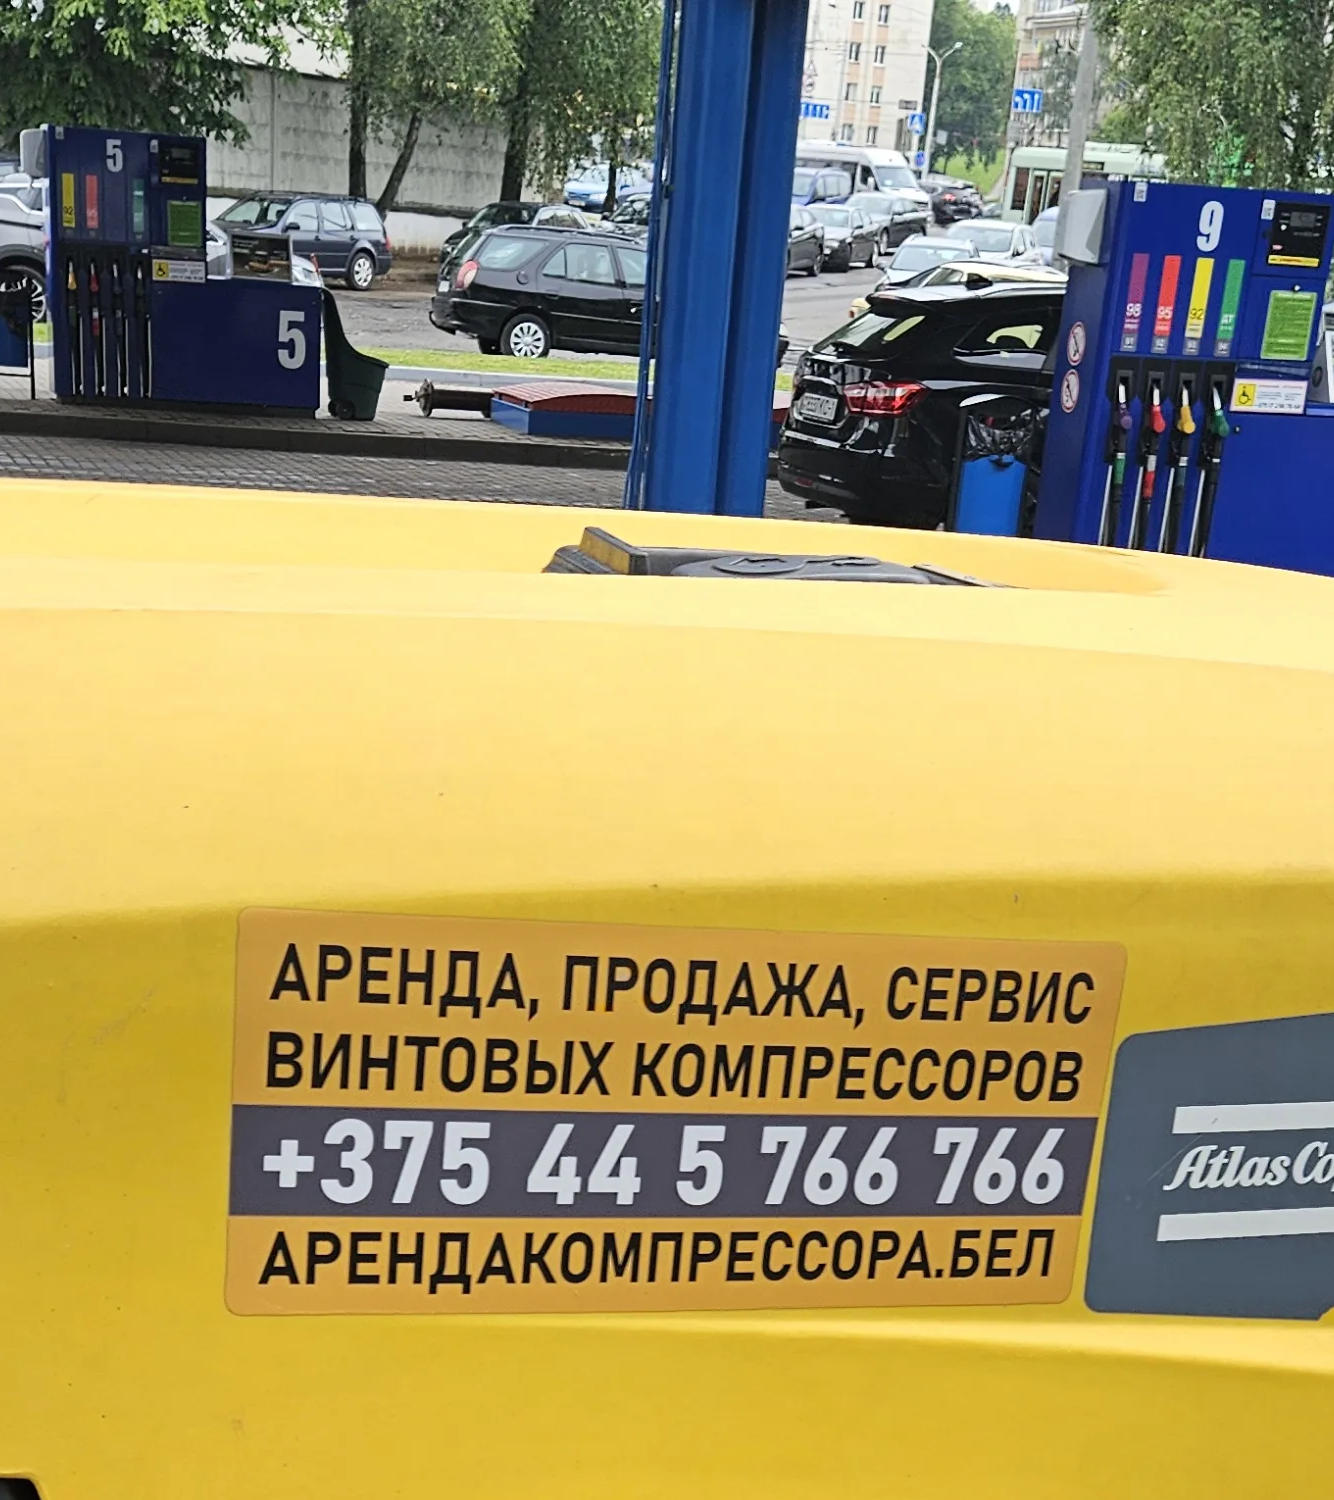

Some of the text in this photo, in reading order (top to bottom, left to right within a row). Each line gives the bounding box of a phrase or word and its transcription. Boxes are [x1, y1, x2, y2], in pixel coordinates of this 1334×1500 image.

[105, 139, 123, 172] 5
[1196, 201, 1224, 252] 9
[277, 310, 306, 369] 5
[1126, 303, 1142, 318] 98
[1157, 306, 1173, 319] 95
[1189, 308, 1204, 320] 92
[269, 943, 1095, 1030] АРЕНДА, ПРОДАЖА, СЕРВИС
[265, 1031, 1085, 1102] ВИНТОВЫХ КОМПРЕССОРОВ
[263, 1118, 1066, 1206] +375 44 5 766 766
[1163, 1144, 1293, 1191] Atlas
[257, 1227, 1055, 1295] АРЕНДАКОМПРЕССОРА.БЕЛ
